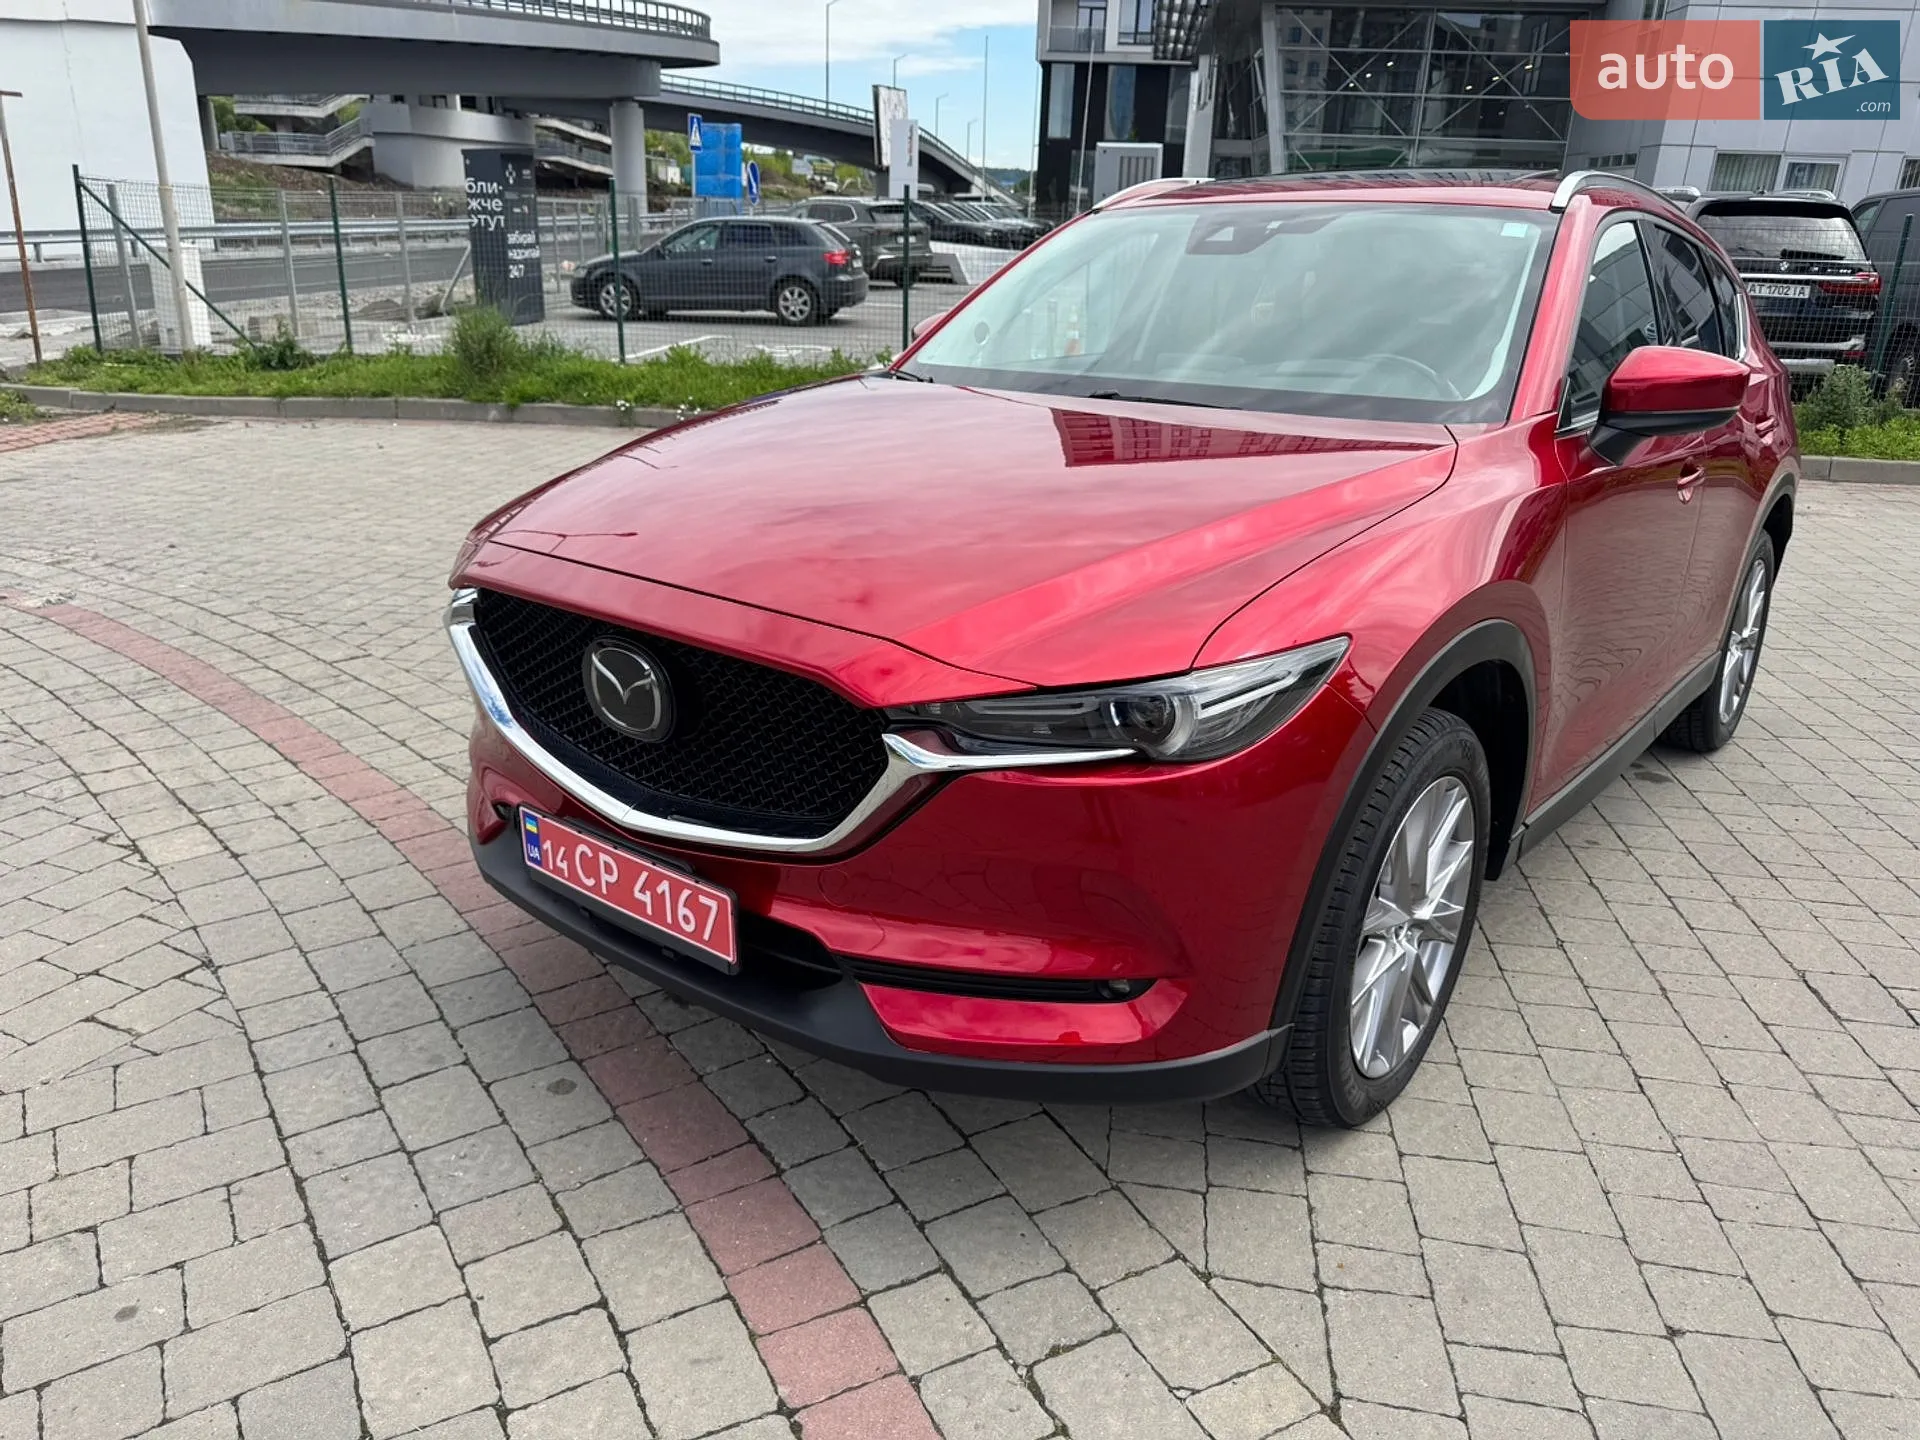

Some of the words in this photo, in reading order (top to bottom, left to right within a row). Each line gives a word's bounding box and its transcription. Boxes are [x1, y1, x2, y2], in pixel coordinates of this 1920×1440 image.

[467, 198, 503, 212] жче
[478, 215, 505, 231] тут
[1749, 283, 1765, 294] AT
[1766, 284, 1791, 295] 1702
[527, 843, 541, 861] UA
[633, 870, 719, 942] 4167
